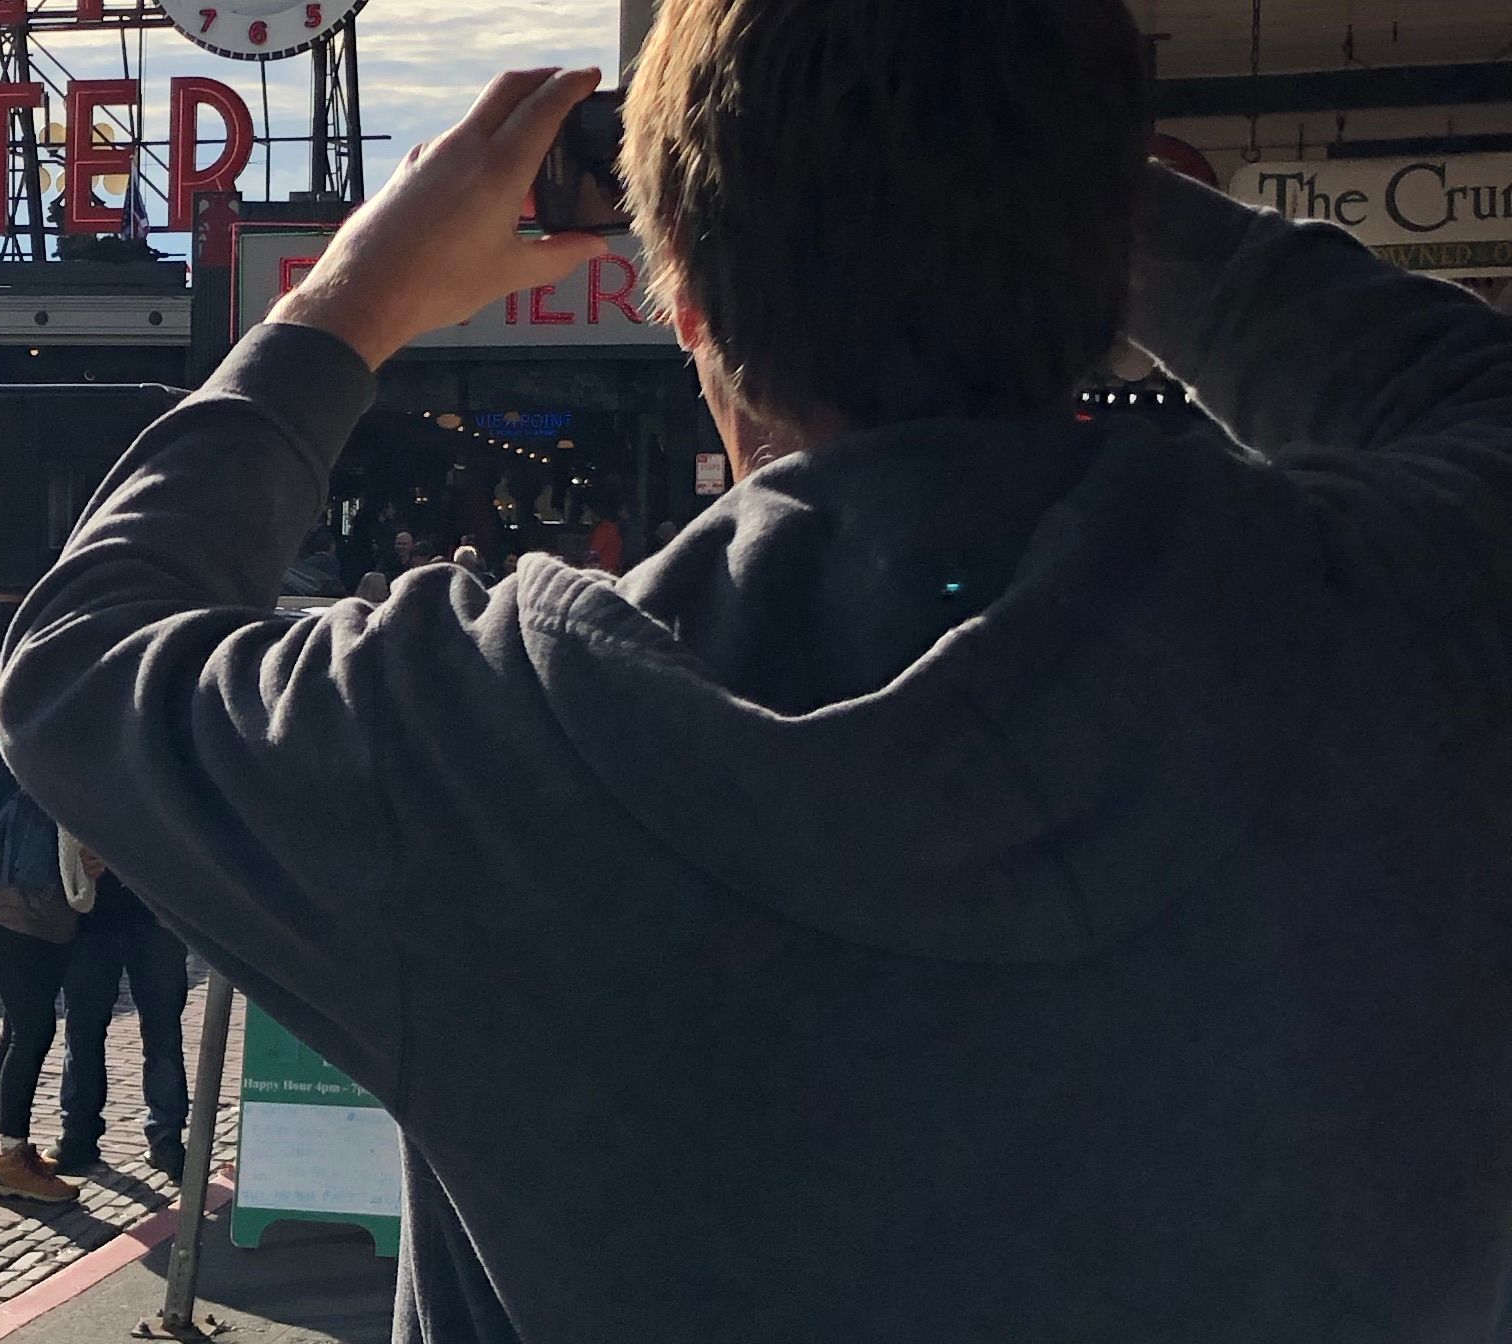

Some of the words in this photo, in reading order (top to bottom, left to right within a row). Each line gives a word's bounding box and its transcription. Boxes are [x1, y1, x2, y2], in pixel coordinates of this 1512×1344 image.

[199, 8, 217, 33] 7
[304, 4, 322, 28] 5
[248, 20, 268, 46] 6
[1258, 171, 1368, 226] The
[243, 1078, 279, 1093] Happy
[283, 1079, 313, 1092] Hour
[315, 1081, 340, 1095] 4pm
[351, 1082, 368, 1097] 7p
